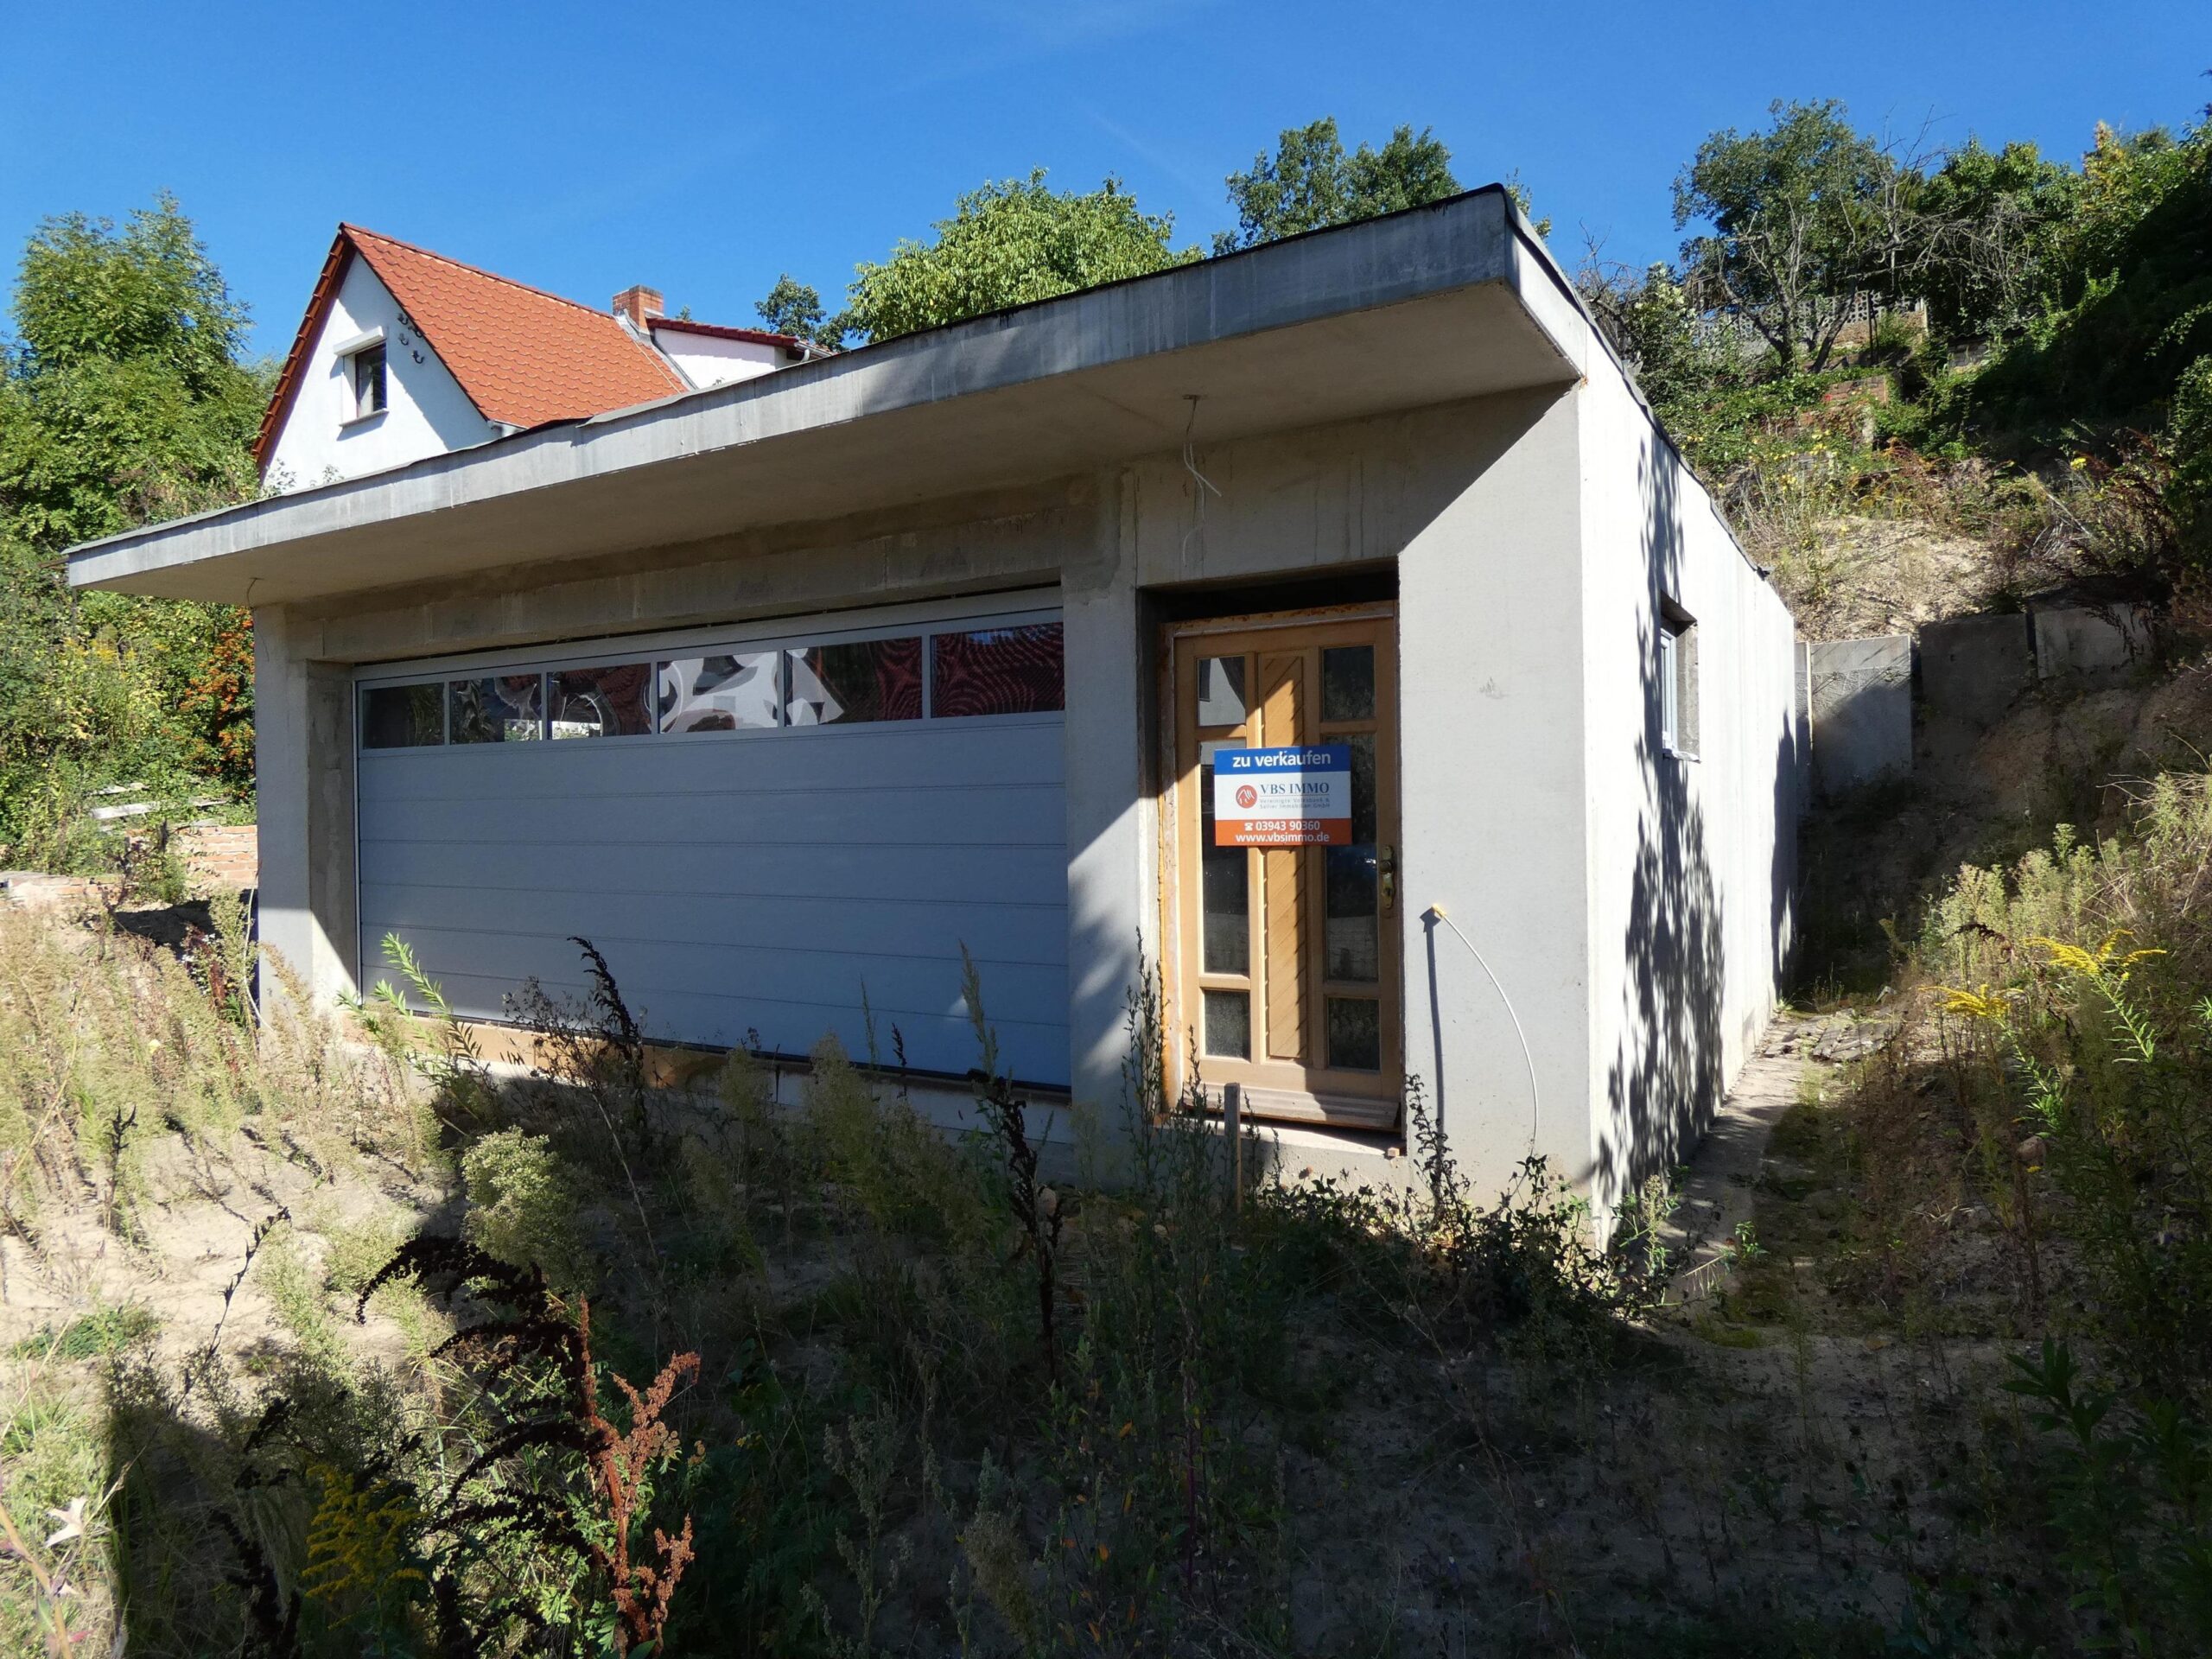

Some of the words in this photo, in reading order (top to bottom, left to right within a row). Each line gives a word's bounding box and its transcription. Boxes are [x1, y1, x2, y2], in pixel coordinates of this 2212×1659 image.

[1232, 756, 1250, 767] zu
[1255, 750, 1331, 766] verkaufen
[1260, 784, 1286, 794] VBS
[1289, 782, 1330, 793] IMMO
[1255, 821, 1287, 831] 03943
[1289, 821, 1320, 831] 90360
[1236, 832, 1331, 842] www.vbsimmo.de
